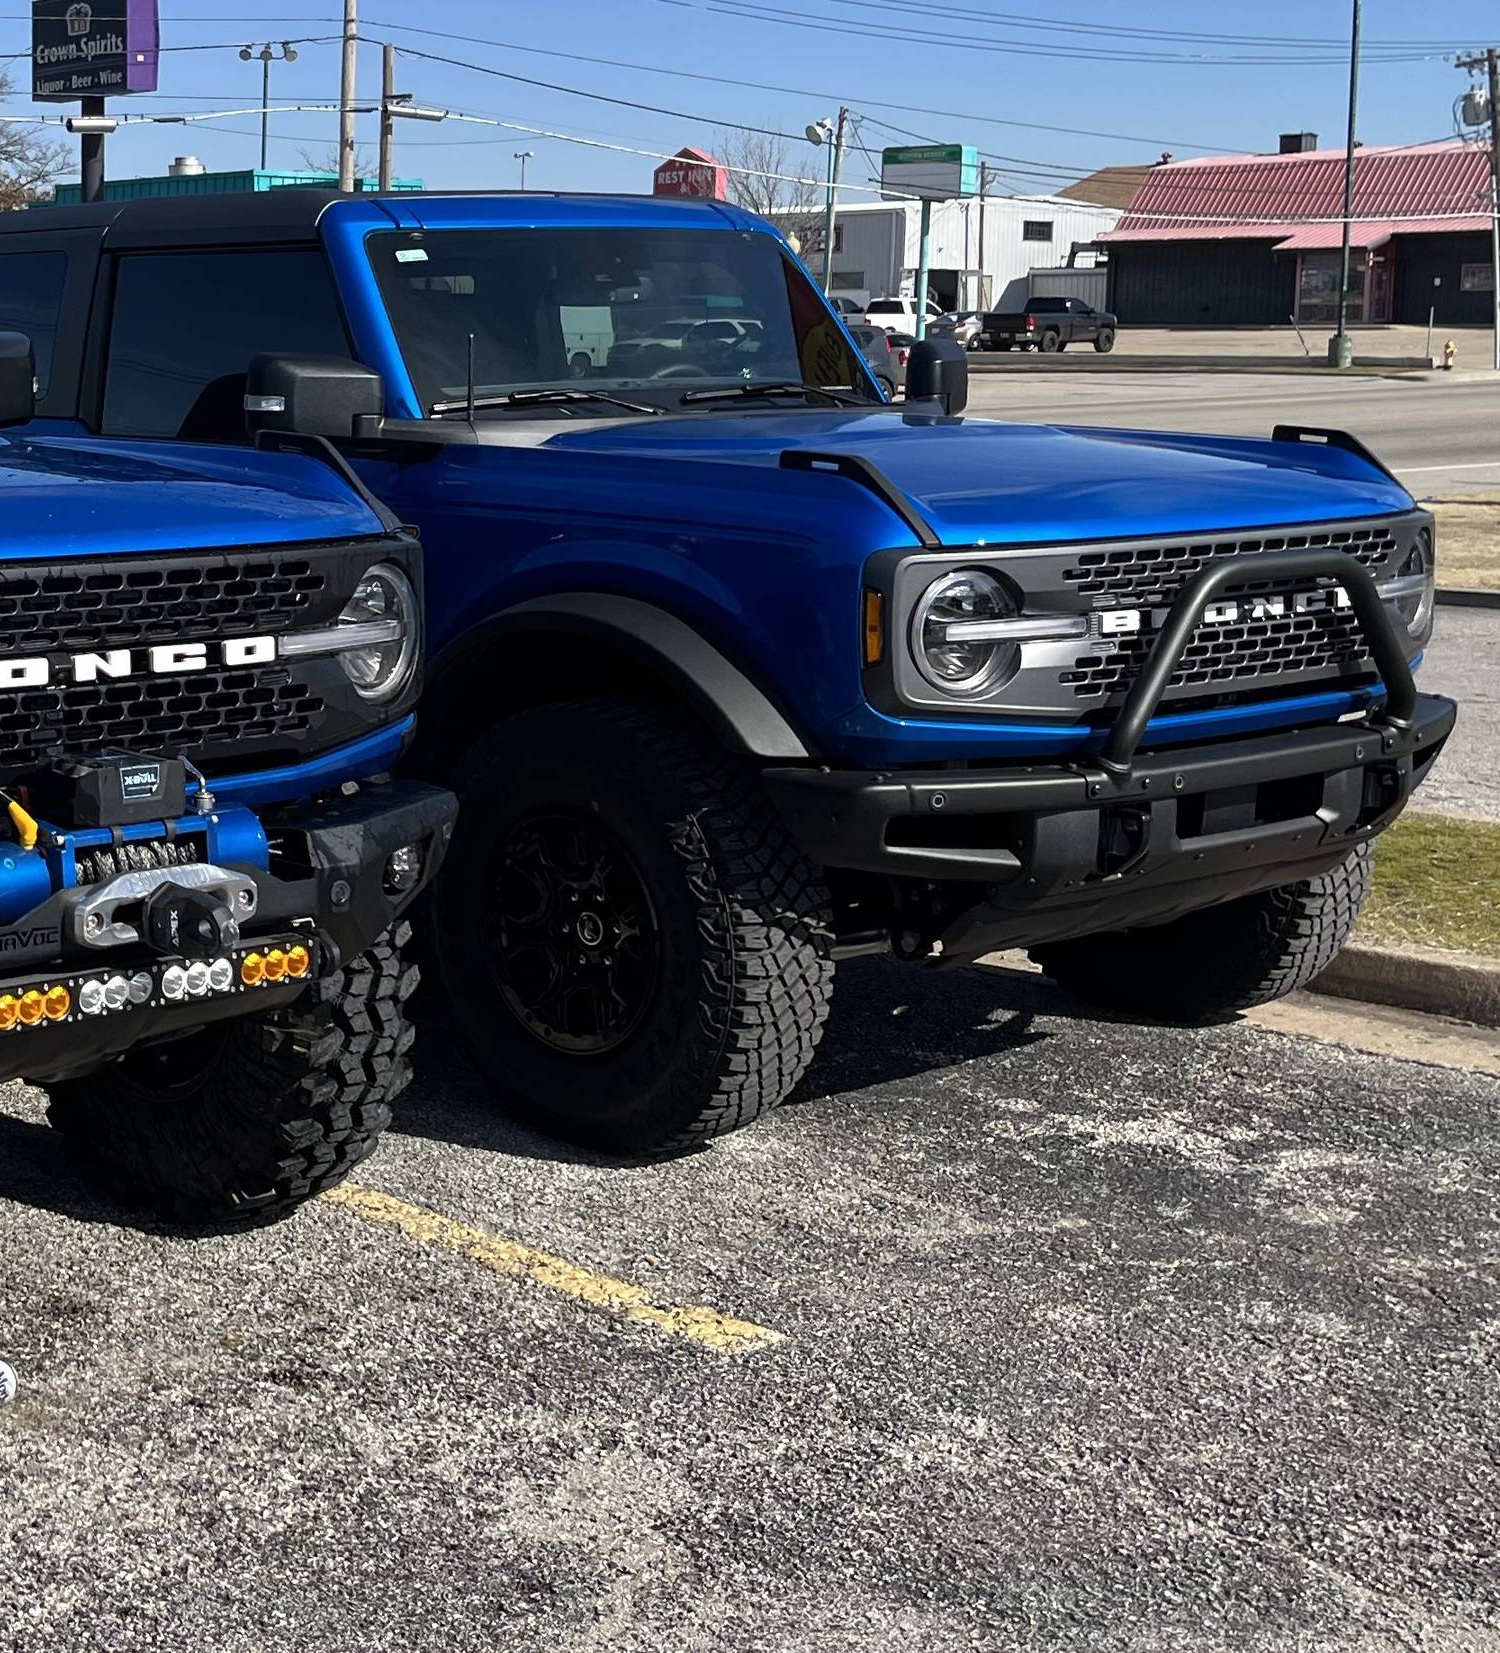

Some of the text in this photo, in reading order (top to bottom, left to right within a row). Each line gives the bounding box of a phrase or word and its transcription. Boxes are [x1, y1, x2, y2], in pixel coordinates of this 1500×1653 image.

[36, 33, 124, 65] Crown Spirits
[36, 69, 123, 95] Liquor Beer Wine
[657, 167, 715, 185] REST INN
[123, 772, 157, 786] X-BULL
[169, 909, 180, 948] APEX
